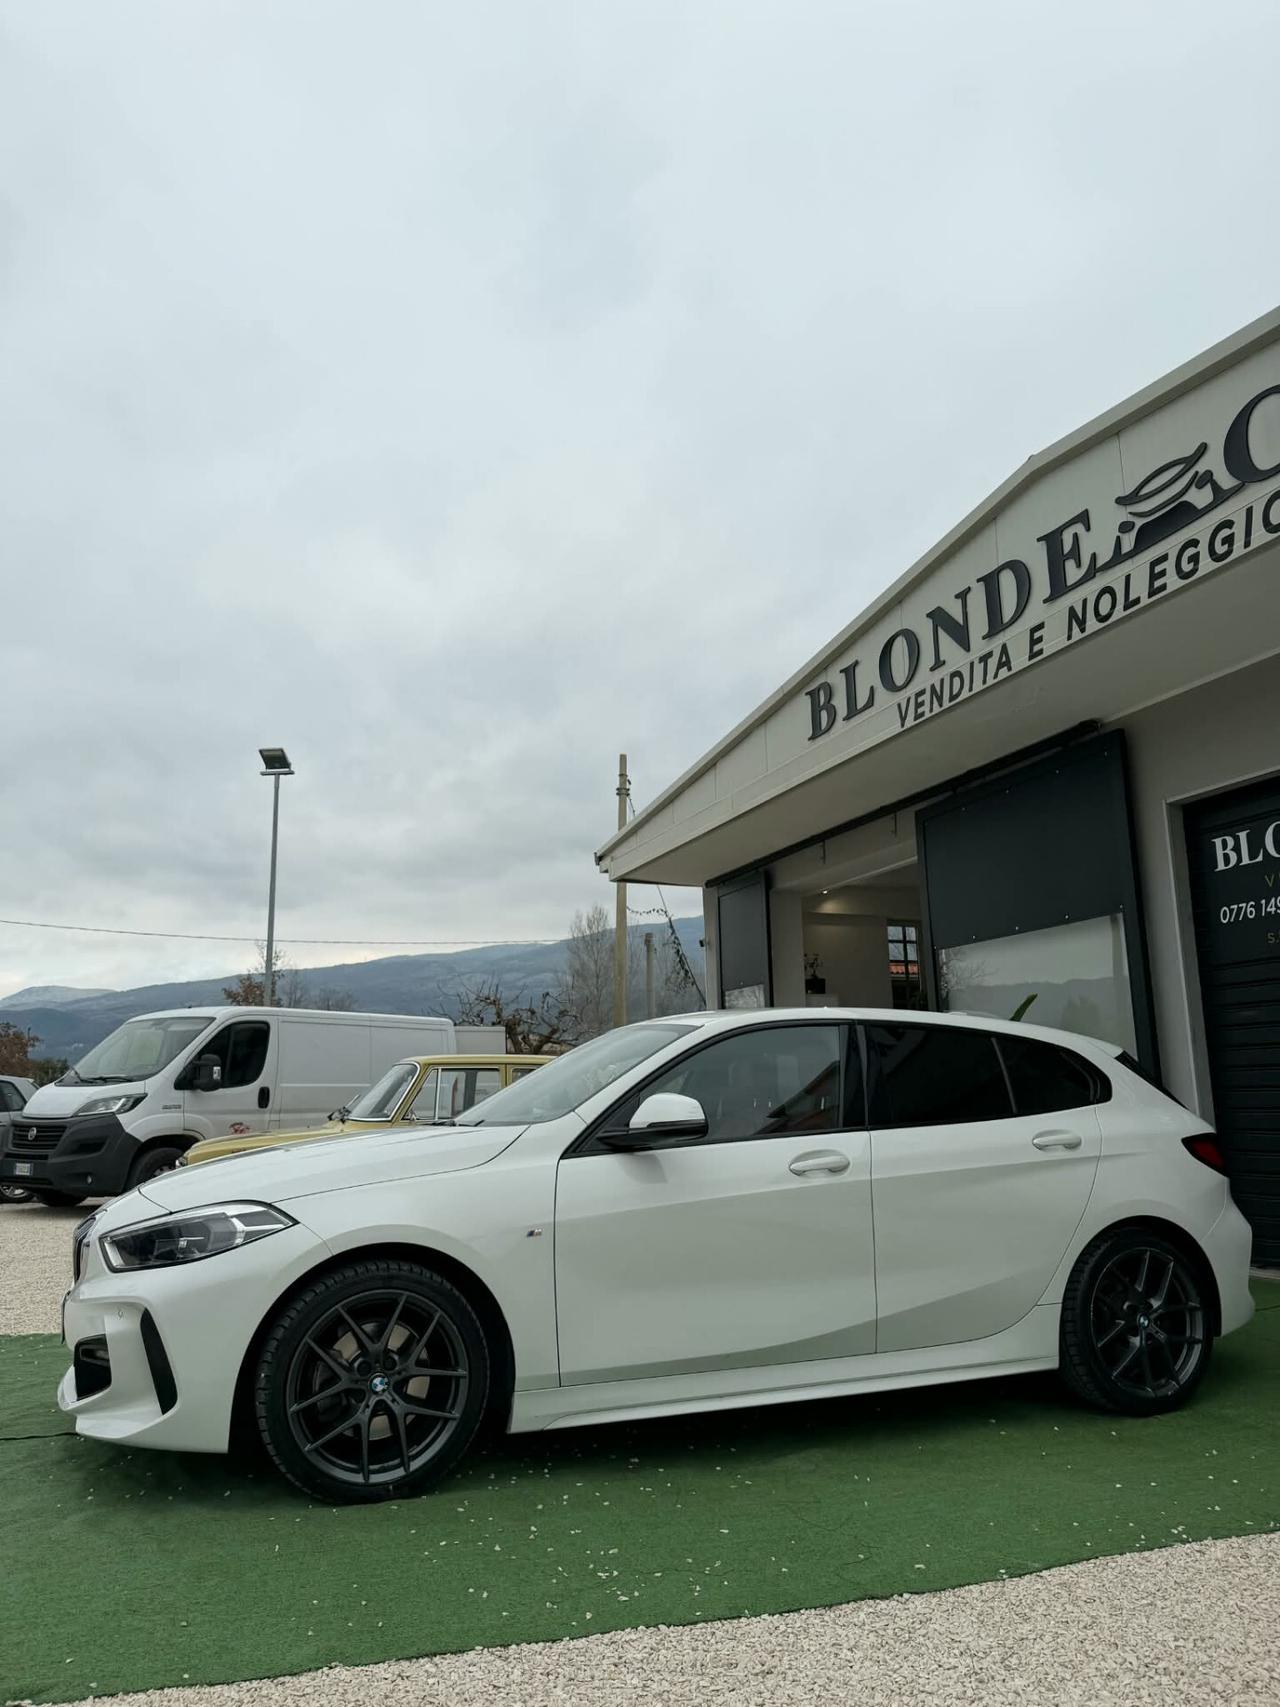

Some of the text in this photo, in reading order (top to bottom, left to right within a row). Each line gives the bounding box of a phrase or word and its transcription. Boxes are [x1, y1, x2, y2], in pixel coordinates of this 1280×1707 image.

[804, 508, 1097, 741] BLONDE
[897, 642, 1013, 728] VENDITA
[1028, 622, 1046, 661] E
[1220, 901, 1256, 924] 0776
